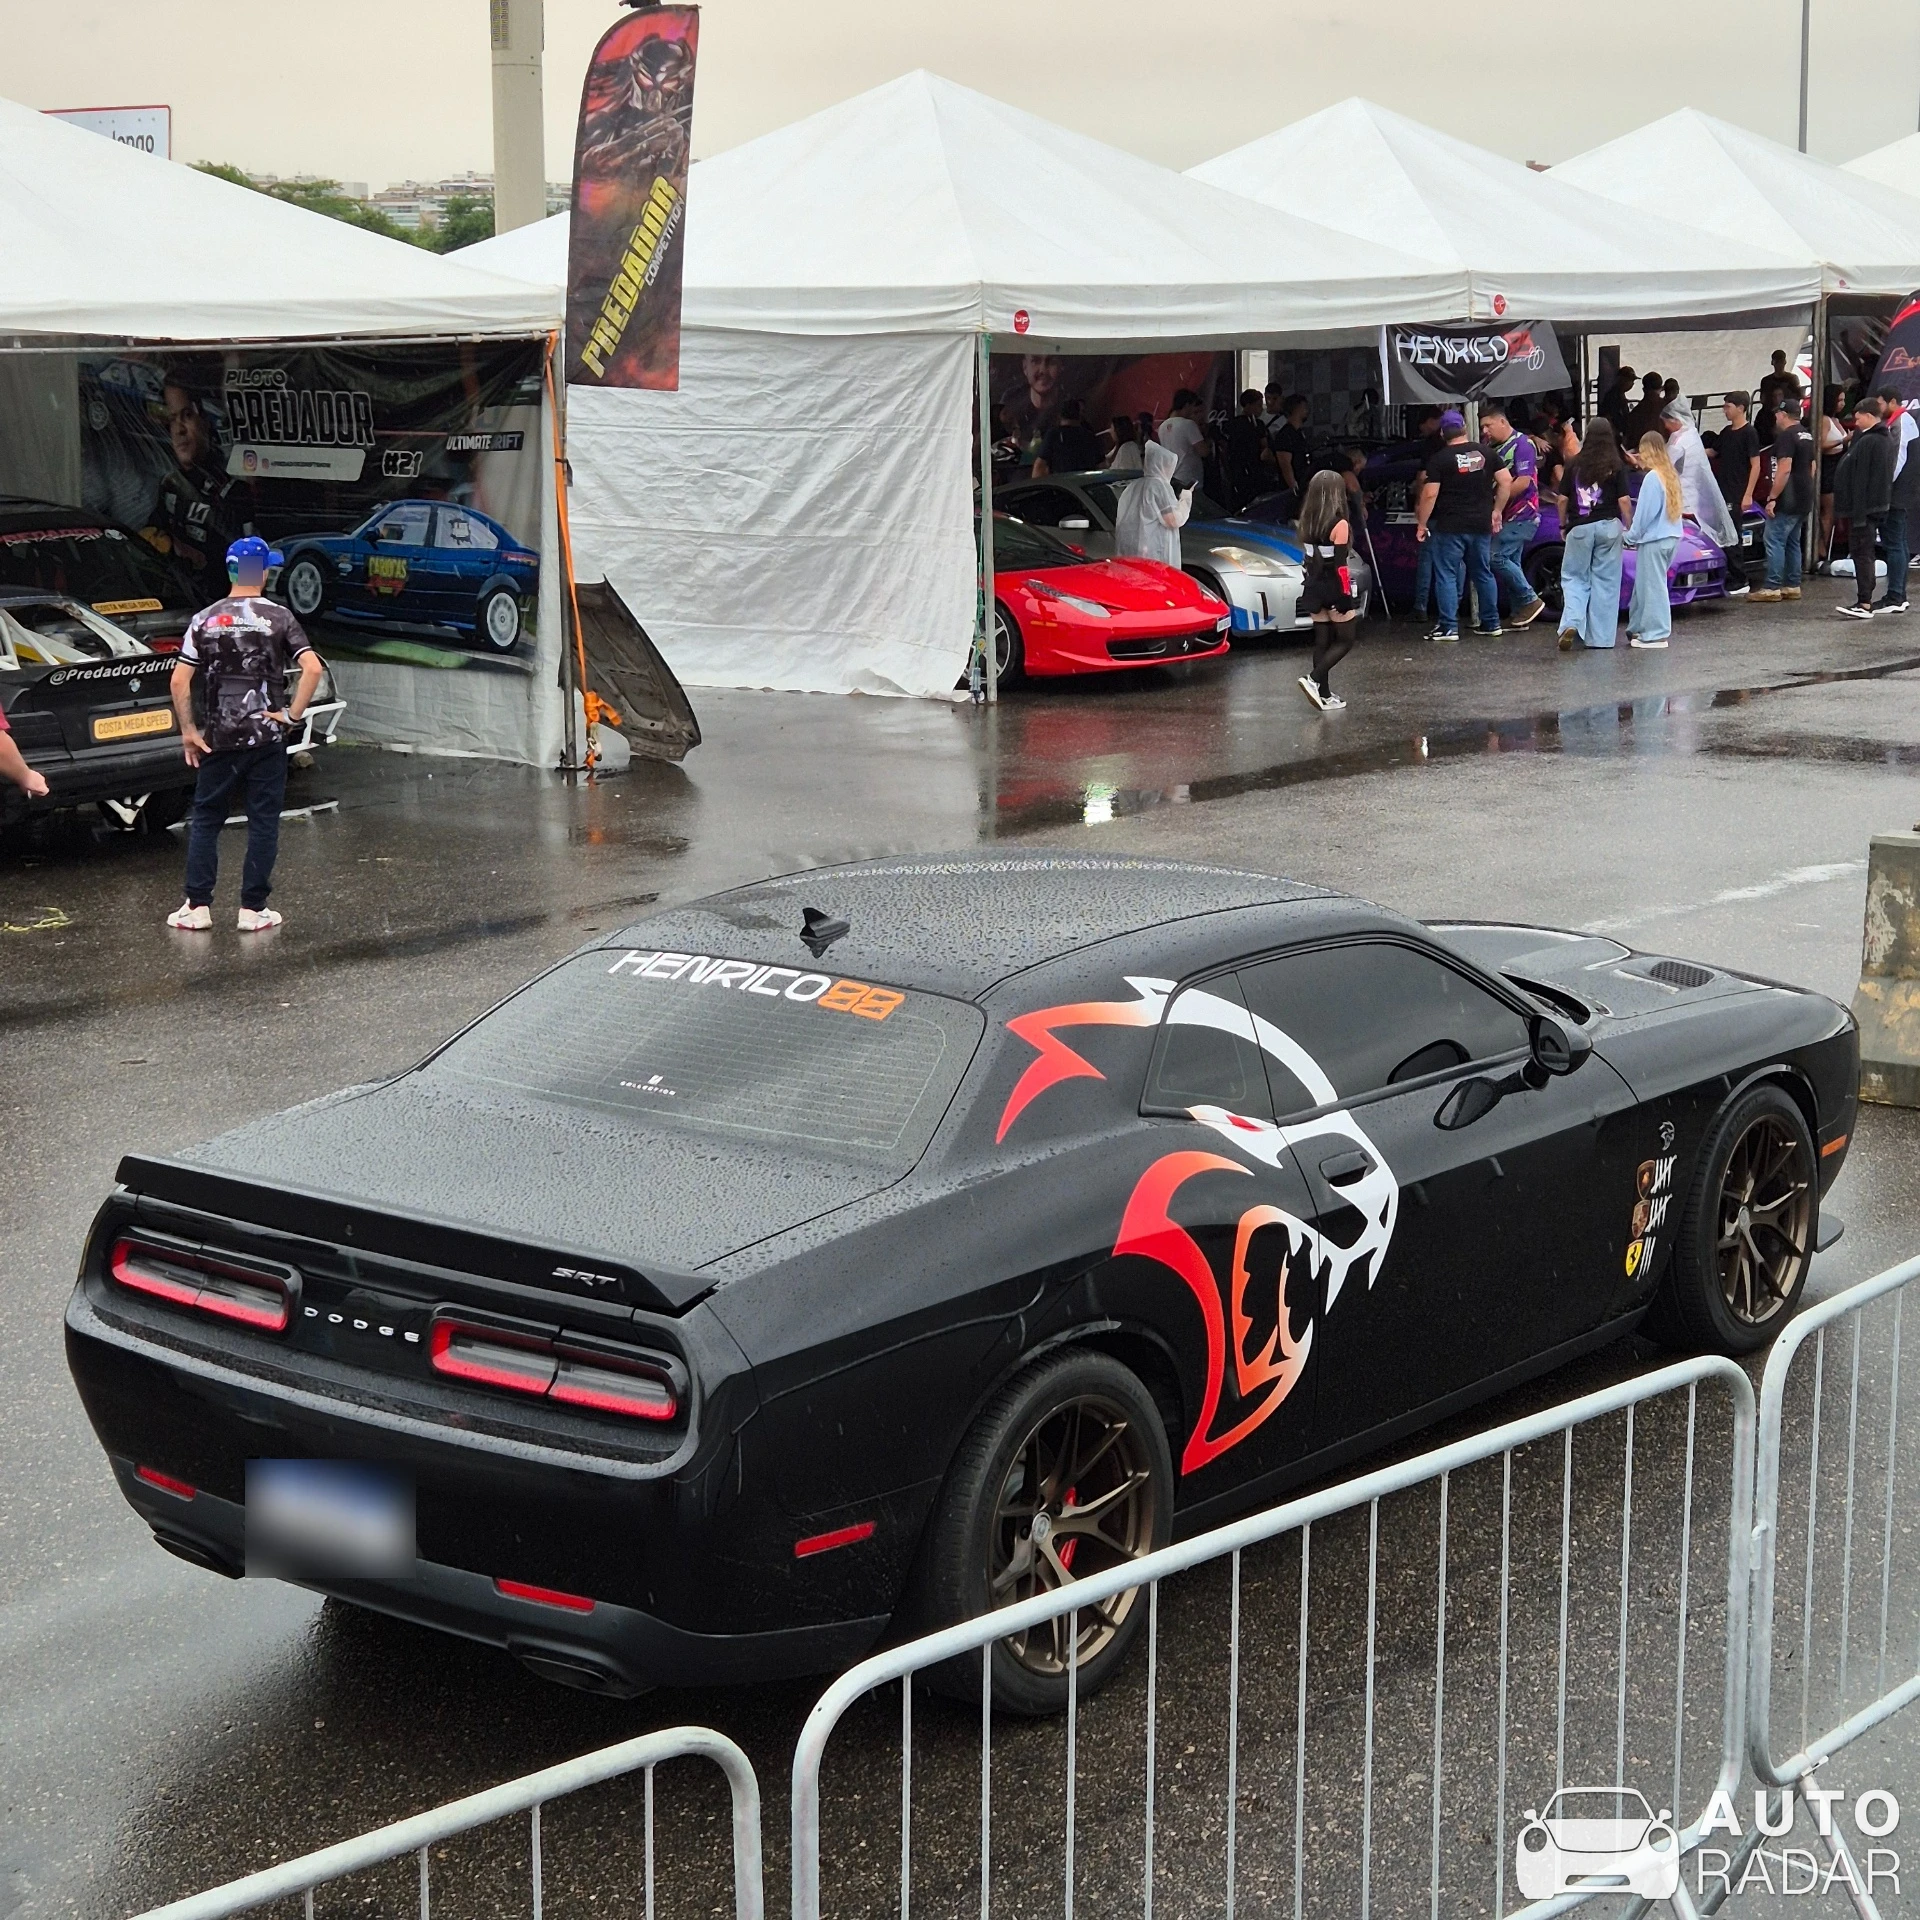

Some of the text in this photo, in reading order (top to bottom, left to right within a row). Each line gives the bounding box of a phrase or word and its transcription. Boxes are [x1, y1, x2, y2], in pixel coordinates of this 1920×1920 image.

[643, 195, 685, 287] COMPETITION
[580, 176, 681, 379] PREDADOR
[224, 368, 287, 387] PILOTO
[225, 389, 376, 446] PREDADOR
[446, 434, 492, 451] ULTIMATE
[382, 449, 424, 477] #21
[98, 713, 169, 735] COSTA MEGA SPEED
[551, 1267, 617, 1287] SRT
[303, 1306, 420, 1343] DODGE
